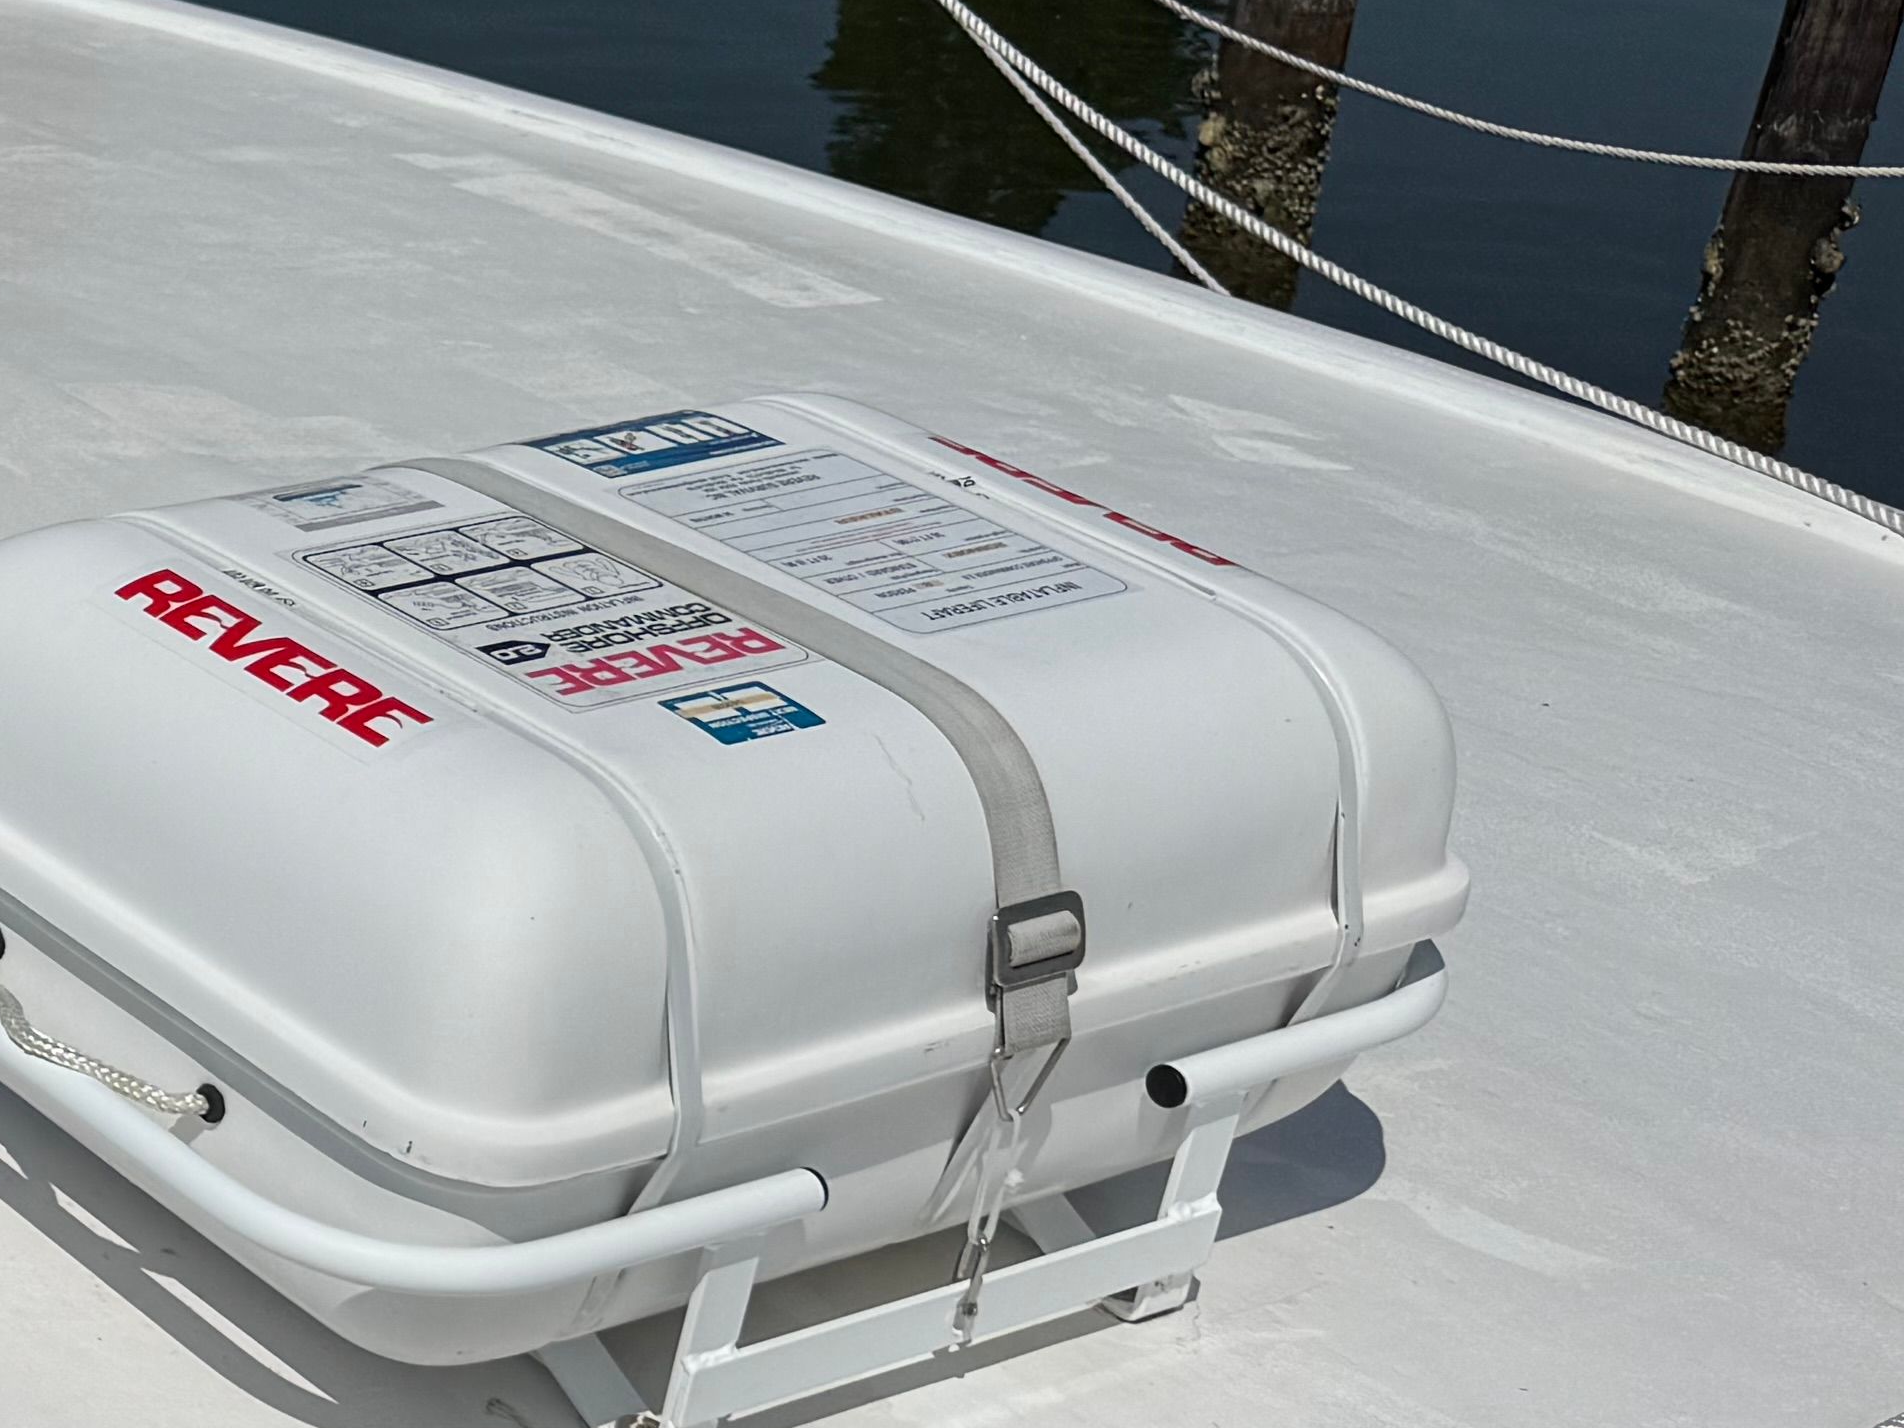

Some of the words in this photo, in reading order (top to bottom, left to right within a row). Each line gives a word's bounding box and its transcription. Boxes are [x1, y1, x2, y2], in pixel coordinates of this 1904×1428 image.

[578, 595, 645, 613] INFLATION
[994, 581, 1083, 606] INFLATABLE
[484, 605, 578, 632] INSTRUCTIONS
[540, 602, 713, 641] COMMANDER
[921, 597, 998, 621] LIFERAFT
[558, 611, 733, 654] OFFSHORE
[113, 568, 435, 749] REVERE
[489, 643, 540, 661] 2.0
[524, 627, 785, 697] REVERE
